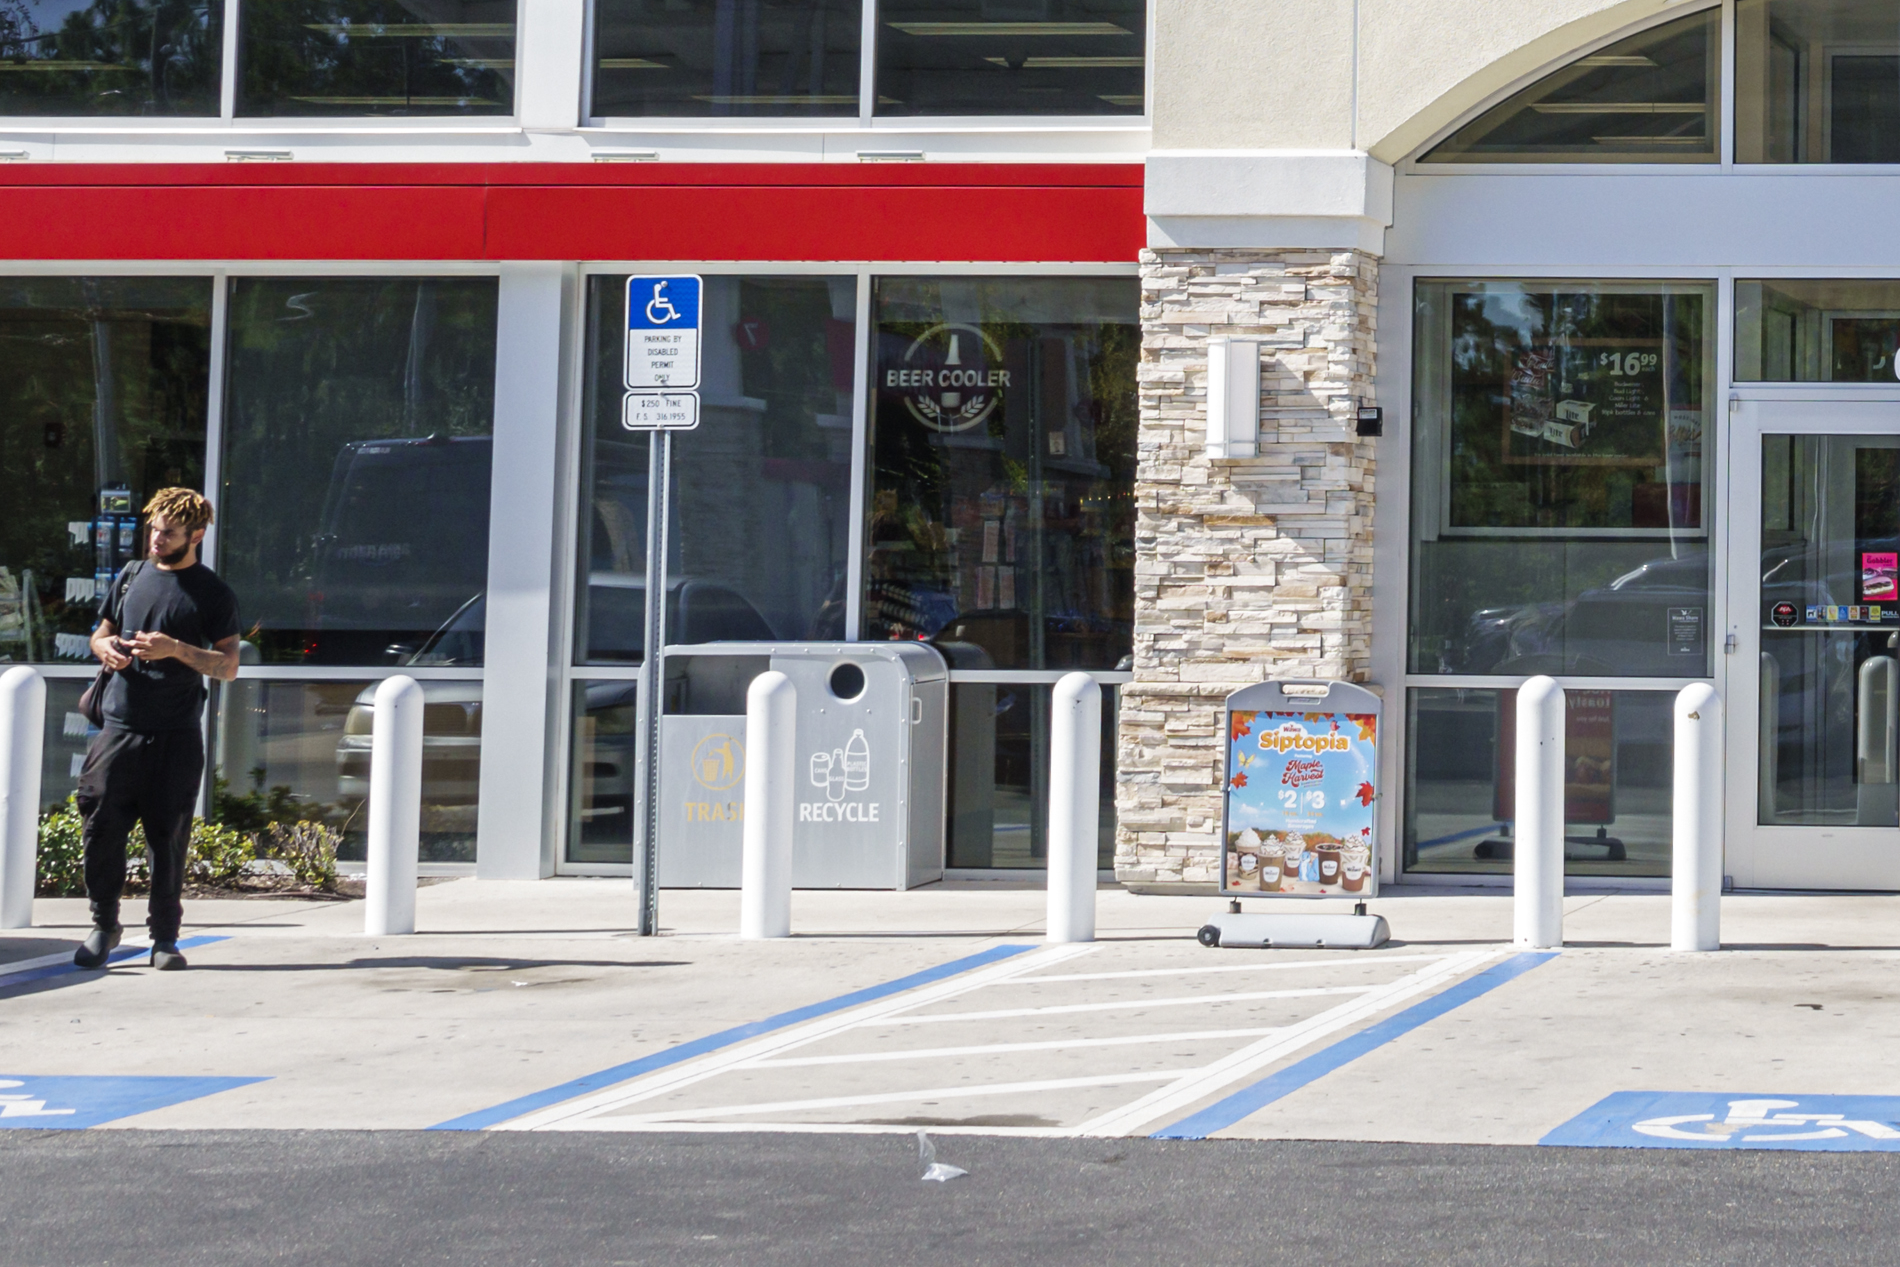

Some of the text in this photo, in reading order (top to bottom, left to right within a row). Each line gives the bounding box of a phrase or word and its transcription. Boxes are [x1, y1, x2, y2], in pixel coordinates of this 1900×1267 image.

[644, 335, 682, 343] PARKING BY
[647, 348, 678, 356] DISABLED
[654, 374, 670, 382] ONLY
[886, 369, 1011, 387] BEER COOLER
[641, 399, 681, 408] $250 FINE
[656, 413, 686, 421] 316.1955
[1260, 731, 1349, 754] Siptopia
[1285, 759, 1323, 774] Maple
[1281, 769, 1324, 788] Harvest
[1278, 789, 1325, 810] $2 $3
[685, 802, 744, 822] TRAS
[800, 802, 880, 822] RECYCLE
